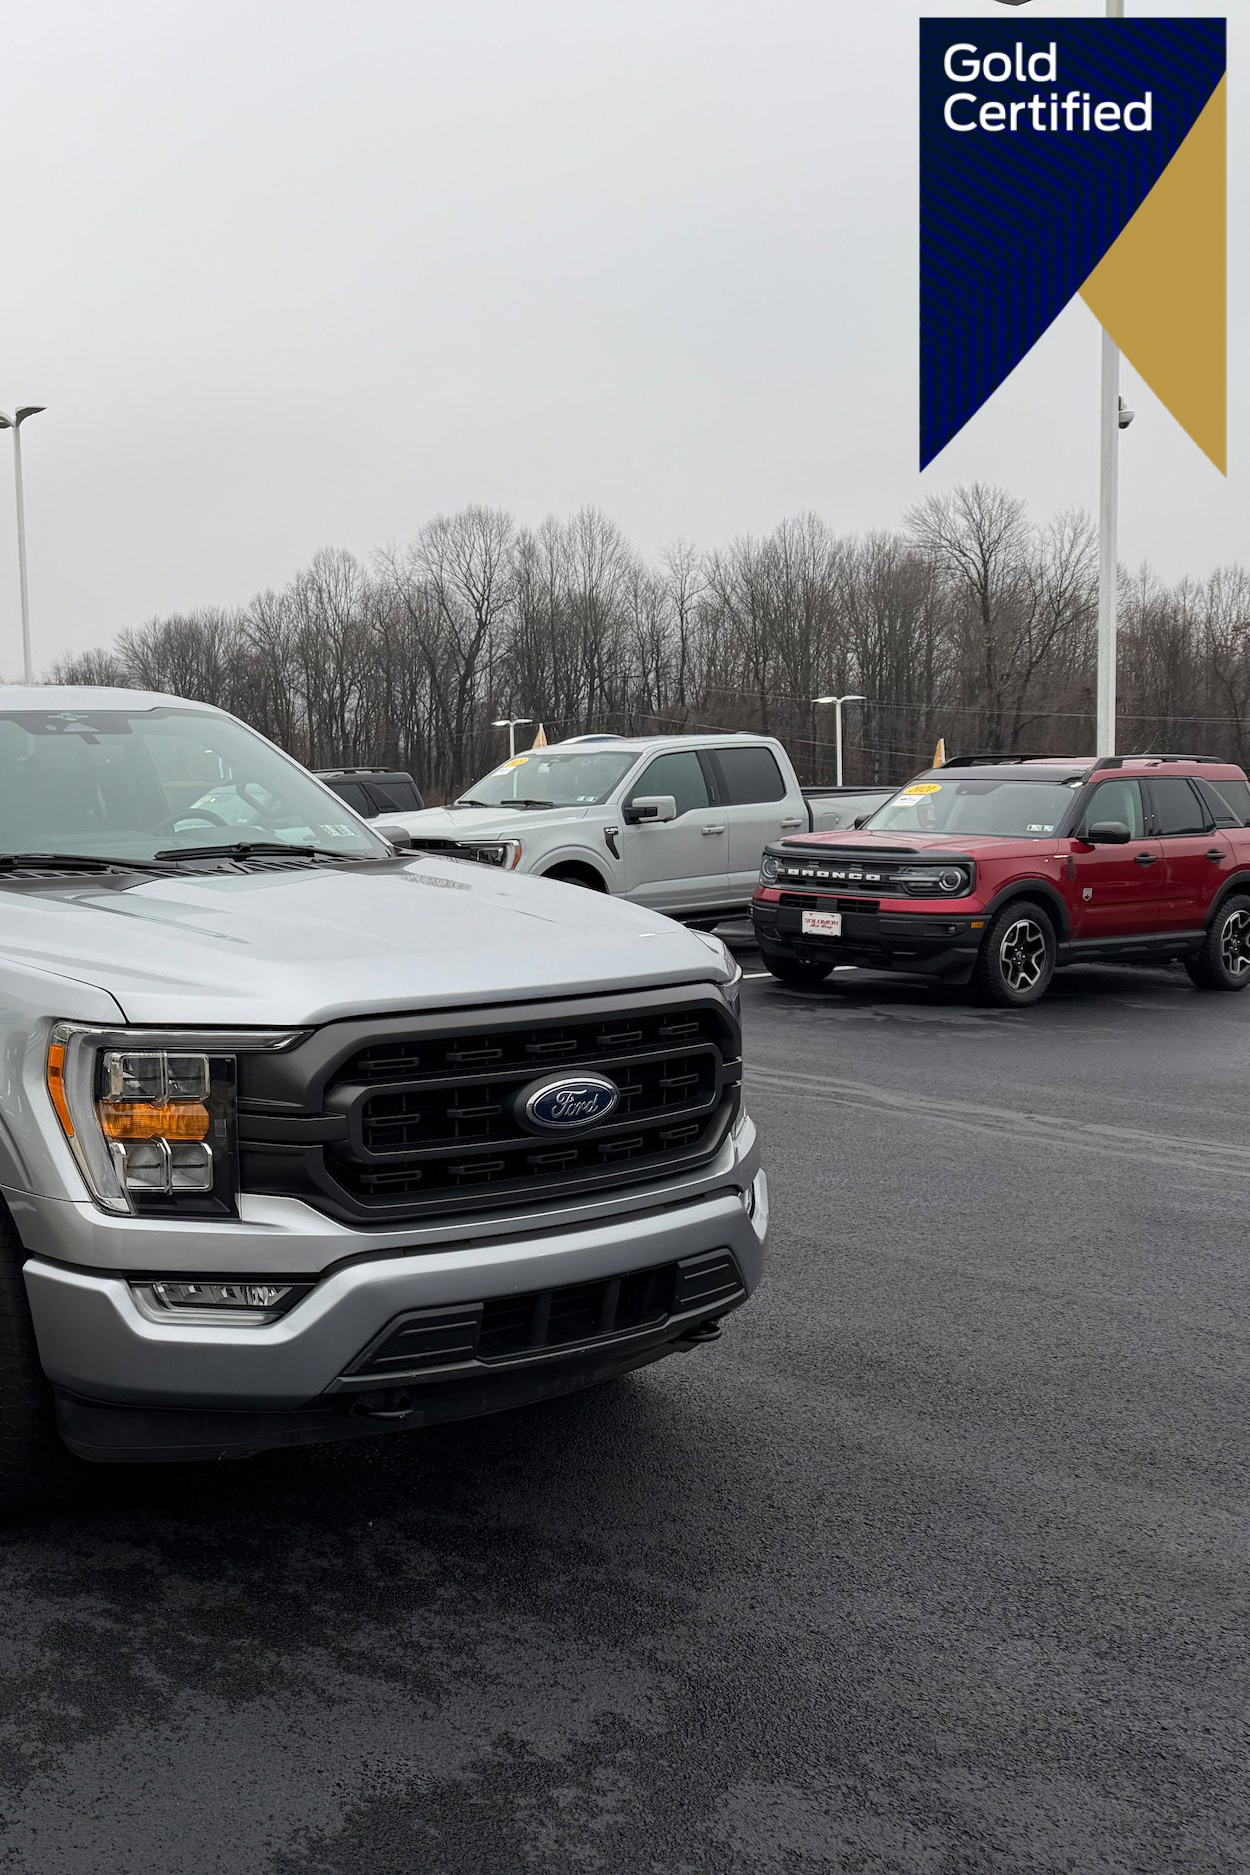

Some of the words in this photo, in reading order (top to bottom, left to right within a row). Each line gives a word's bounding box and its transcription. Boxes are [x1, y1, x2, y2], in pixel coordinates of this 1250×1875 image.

[787, 868, 881, 881] BRONCO
[805, 918, 839, 926] SOLOMON
[551, 1089, 599, 1119] Ford
